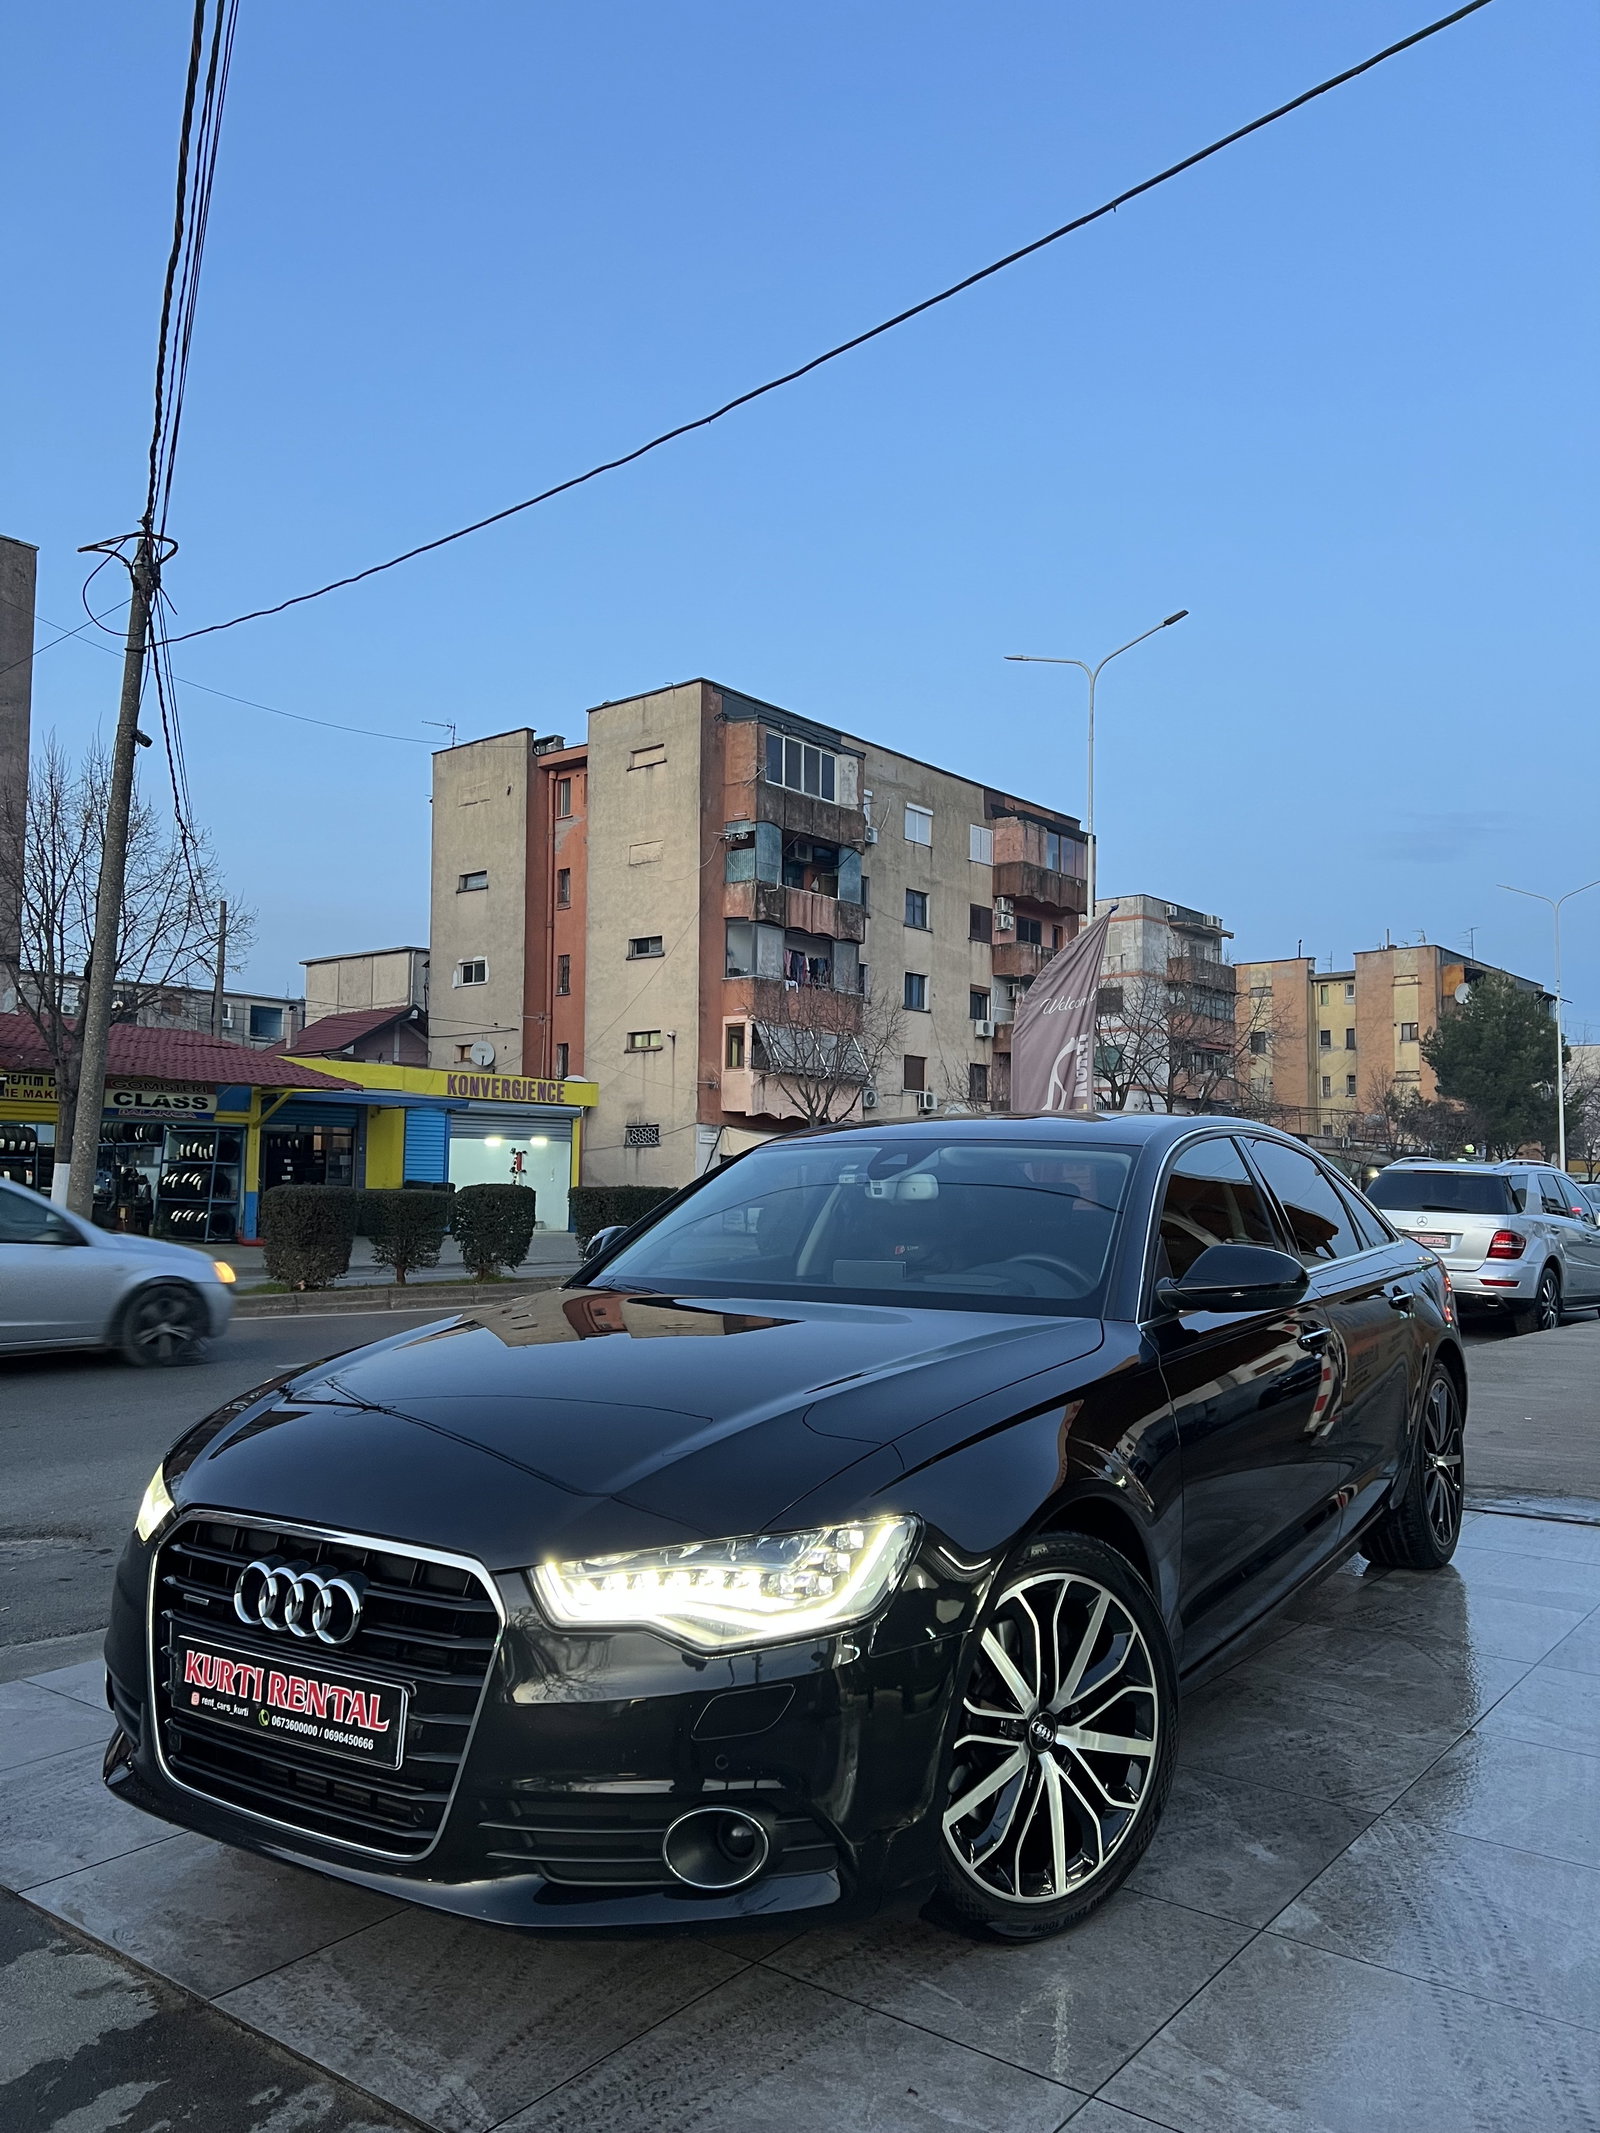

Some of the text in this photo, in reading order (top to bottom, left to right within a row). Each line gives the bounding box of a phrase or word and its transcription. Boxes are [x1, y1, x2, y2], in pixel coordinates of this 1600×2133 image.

[48, 1077, 57, 1087] D
[447, 1074, 565, 1102] KONVERGJENCE
[23, 1089, 58, 1099] MAKI
[113, 1092, 208, 1110] CLASS
[184, 1650, 390, 1732] KURTI RENTAL
[201, 1697, 249, 1717] rent_cars_kurti
[271, 1715, 318, 1737] 0673600000
[324, 1728, 374, 1750] 0696450666
